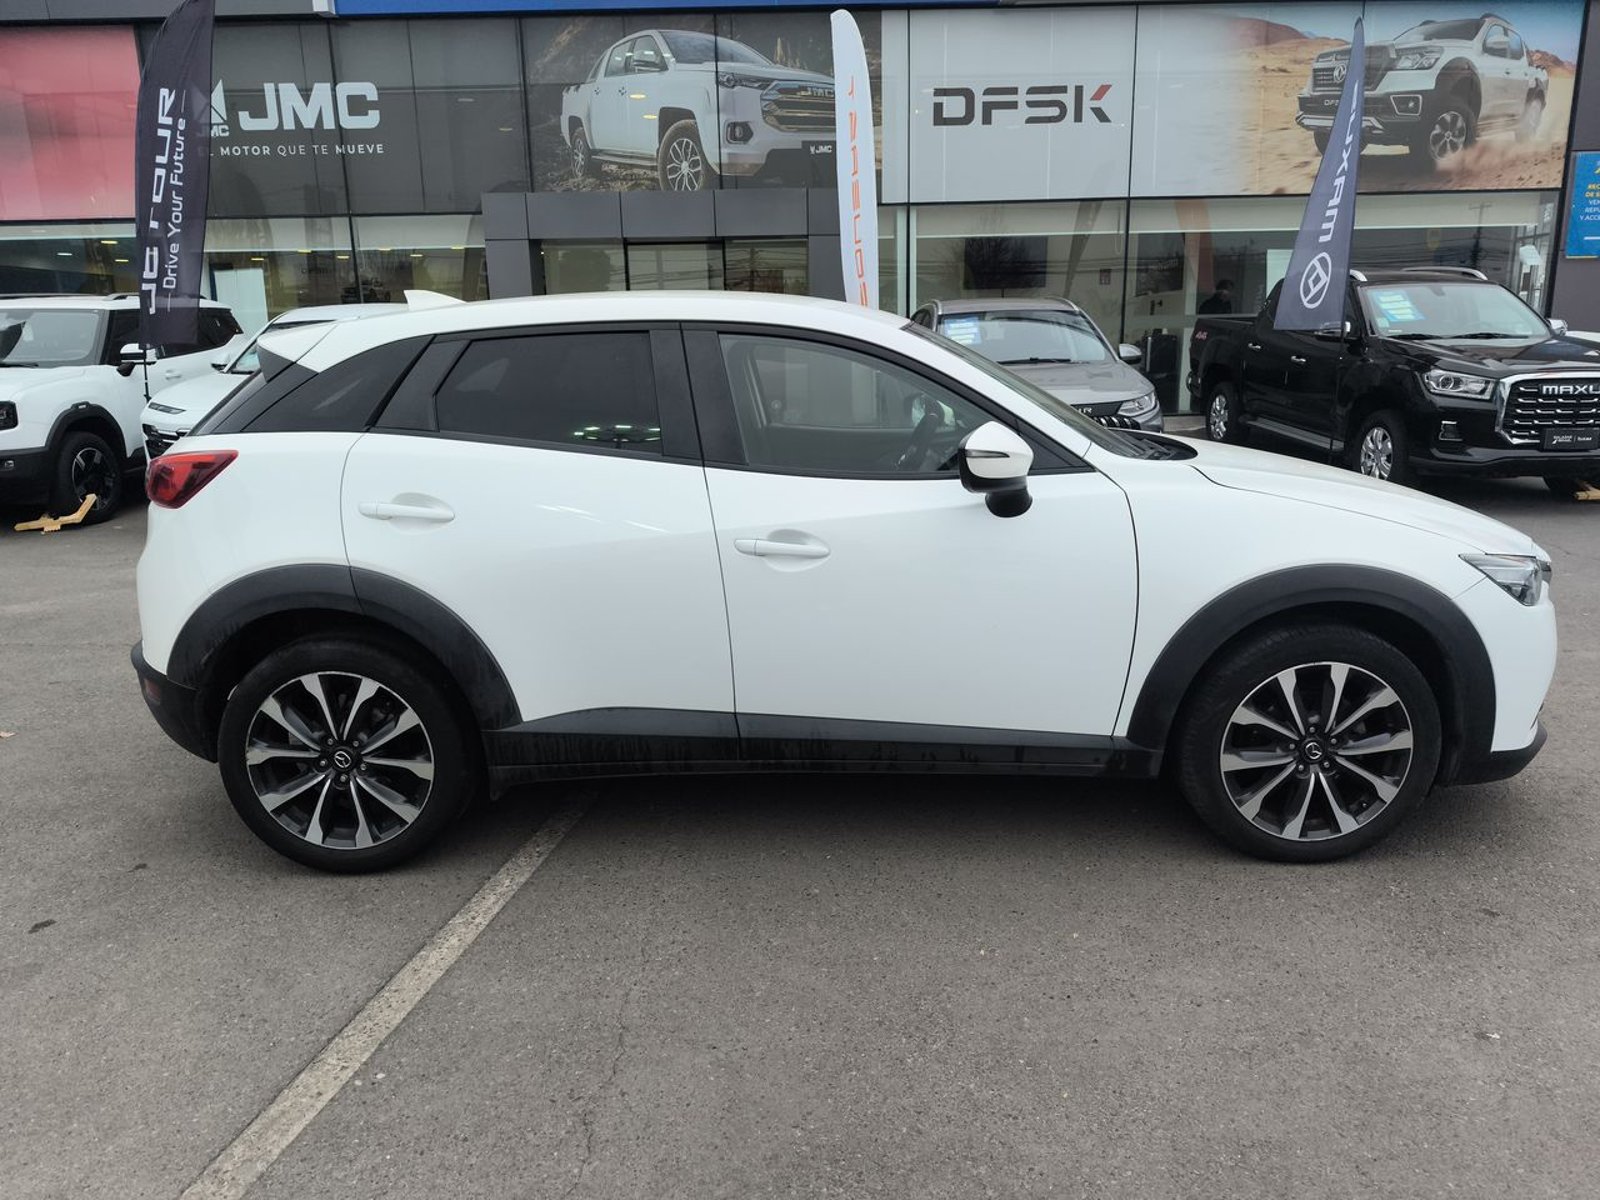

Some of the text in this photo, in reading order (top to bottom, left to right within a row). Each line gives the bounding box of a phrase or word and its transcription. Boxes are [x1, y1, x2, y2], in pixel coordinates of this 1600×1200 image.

[238, 82, 381, 131] JMC
[933, 84, 1112, 126] DFSK
[220, 146, 271, 156] MOTOR
[276, 145, 305, 157] QUE
[313, 145, 329, 155] TE
[335, 144, 385, 155] MUEVE
[163, 117, 187, 289] Drive Your Future
